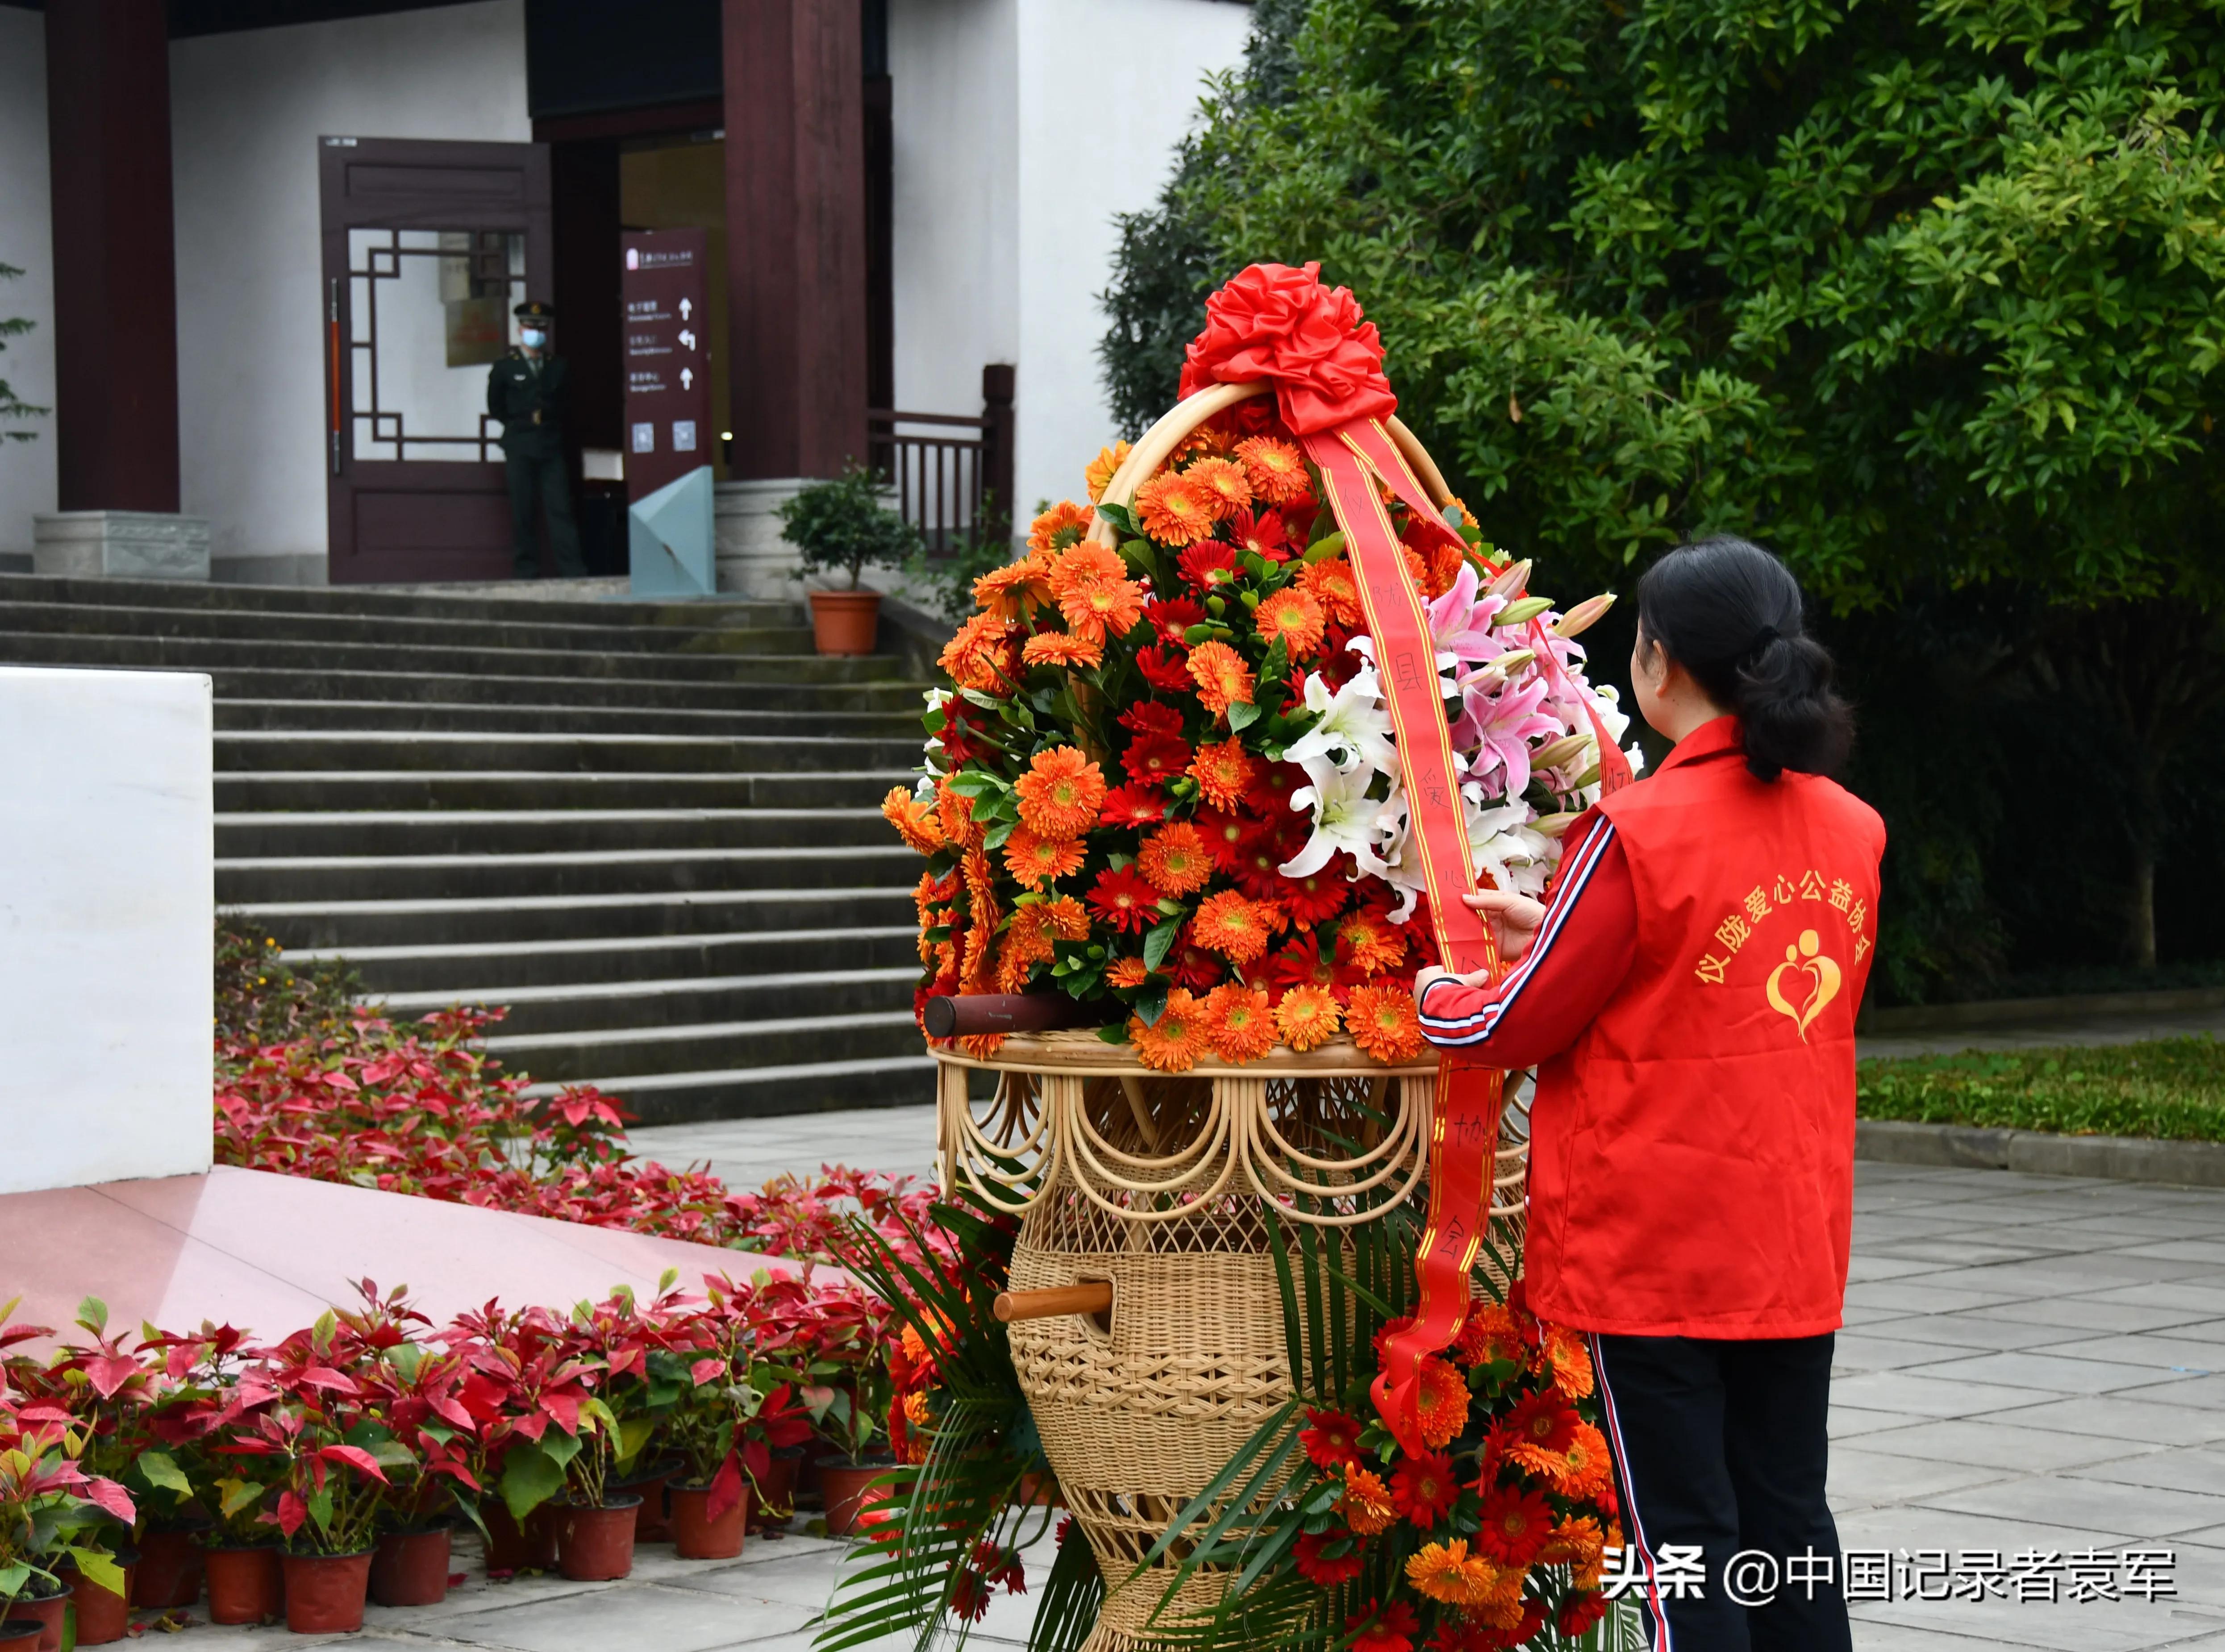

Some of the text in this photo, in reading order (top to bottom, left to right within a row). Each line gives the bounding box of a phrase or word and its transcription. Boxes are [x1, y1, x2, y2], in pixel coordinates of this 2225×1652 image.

[1695, 870, 1871, 984] 仪陇爱心公益协会
